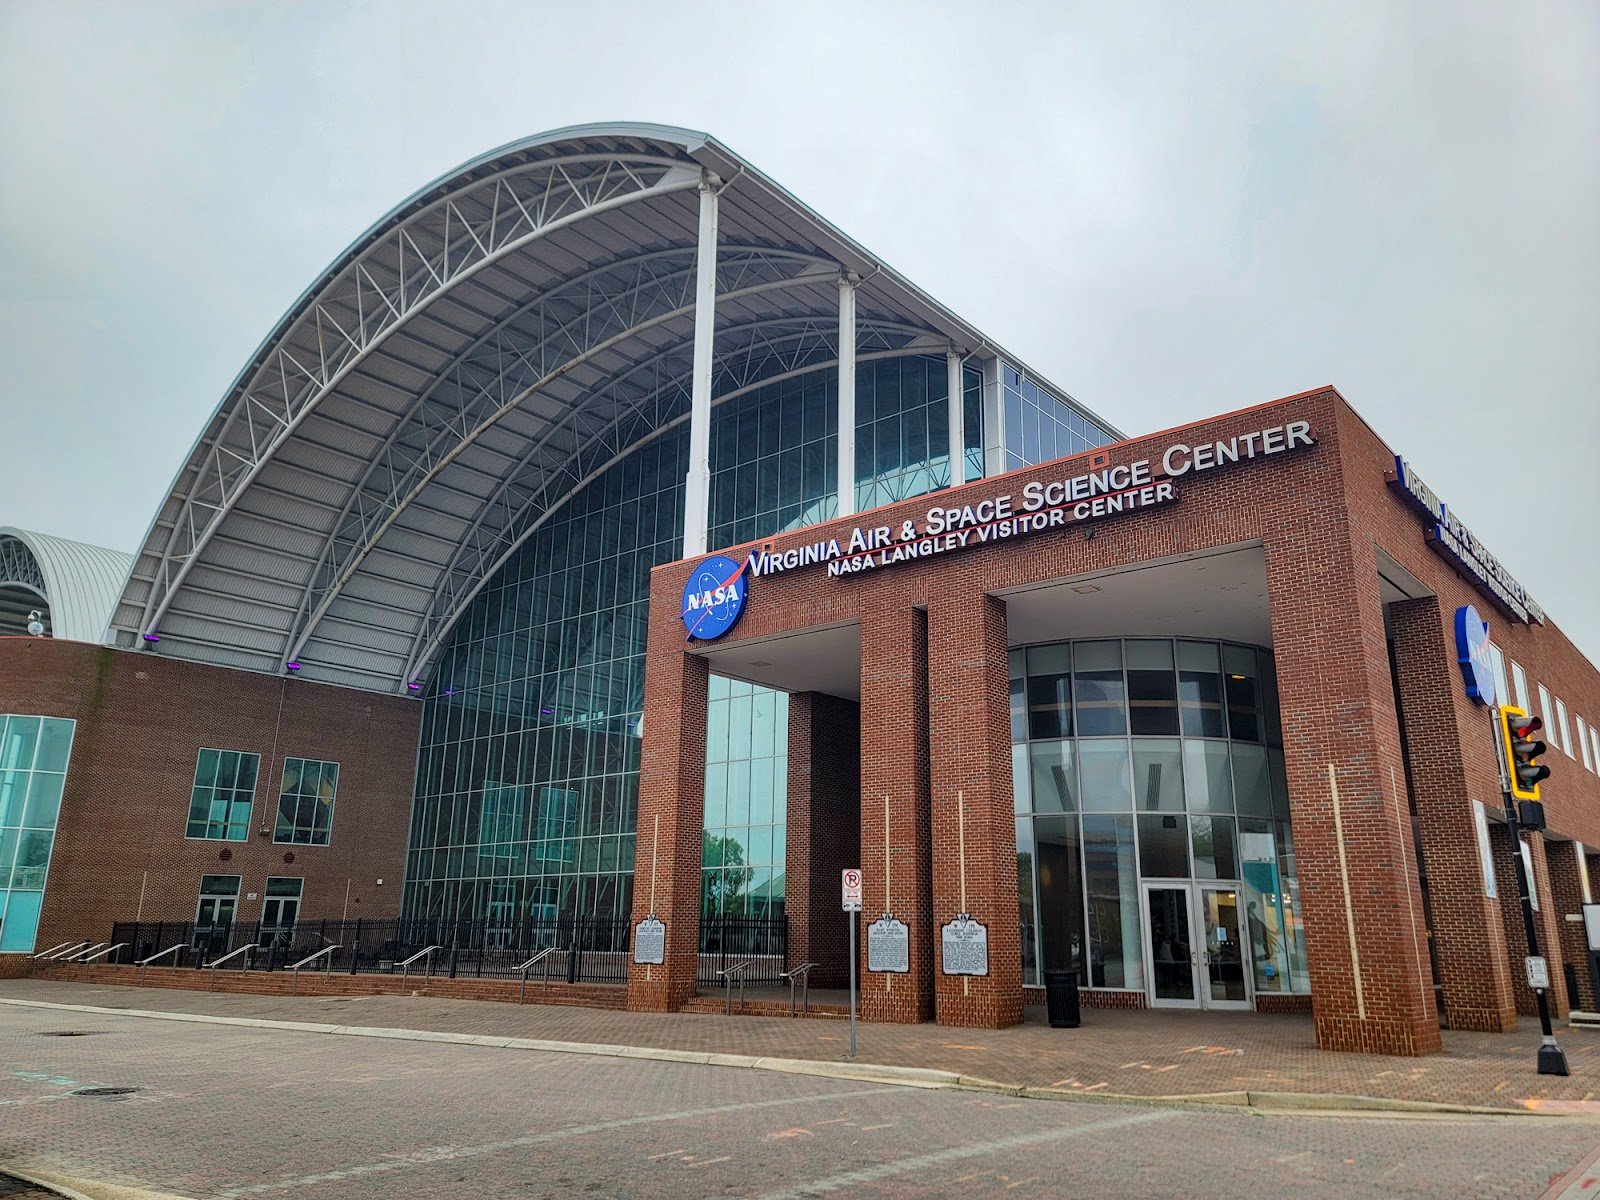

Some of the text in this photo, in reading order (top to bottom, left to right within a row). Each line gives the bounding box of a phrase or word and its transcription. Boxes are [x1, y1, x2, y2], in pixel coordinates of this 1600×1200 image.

[748, 420, 1315, 577] VIRGINIA AIR & SPACE SCIENCE CENTER
[827, 482, 1174, 577] NASA LANGLEY VISITOR CENTER
[1396, 454, 1444, 524] VIRGINIA
[687, 584, 739, 611] NASA
